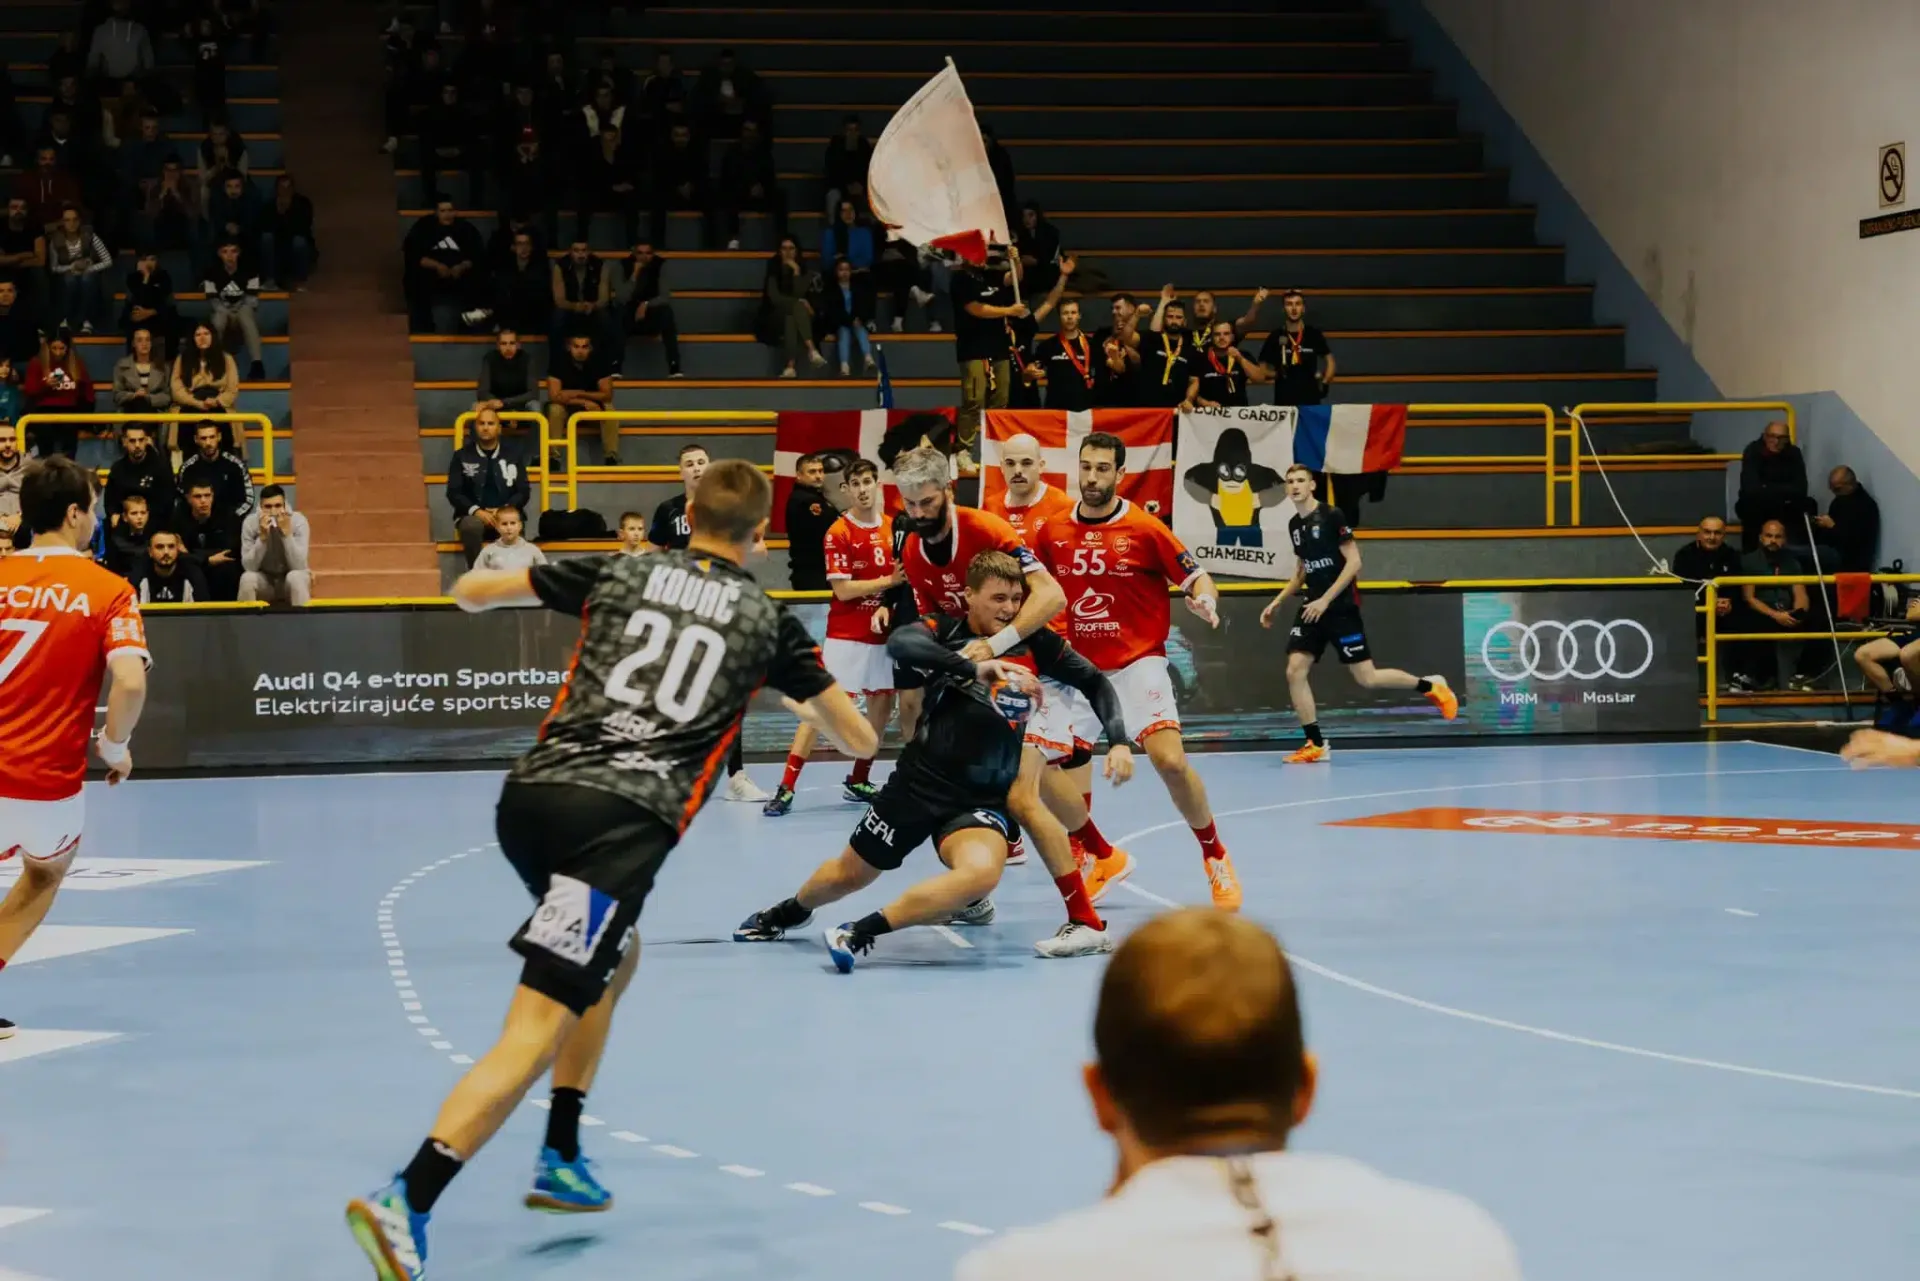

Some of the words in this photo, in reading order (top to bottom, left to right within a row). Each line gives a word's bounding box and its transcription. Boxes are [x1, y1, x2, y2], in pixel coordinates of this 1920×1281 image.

[1238, 407, 1289, 422] GARDE
[672, 515, 691, 536] 18
[873, 547, 886, 566] 8
[1072, 549, 1107, 575] 55
[1195, 546, 1276, 565] CHAMBERY
[604, 608, 727, 723] 20
[253, 672, 314, 691] Audi
[323, 671, 361, 691] Q4
[368, 671, 449, 688] e-tron
[255, 694, 435, 717] Elektrizirajuće
[443, 692, 551, 715] sportske
[1501, 692, 1538, 704] MRM
[1583, 691, 1636, 704] Mostar
